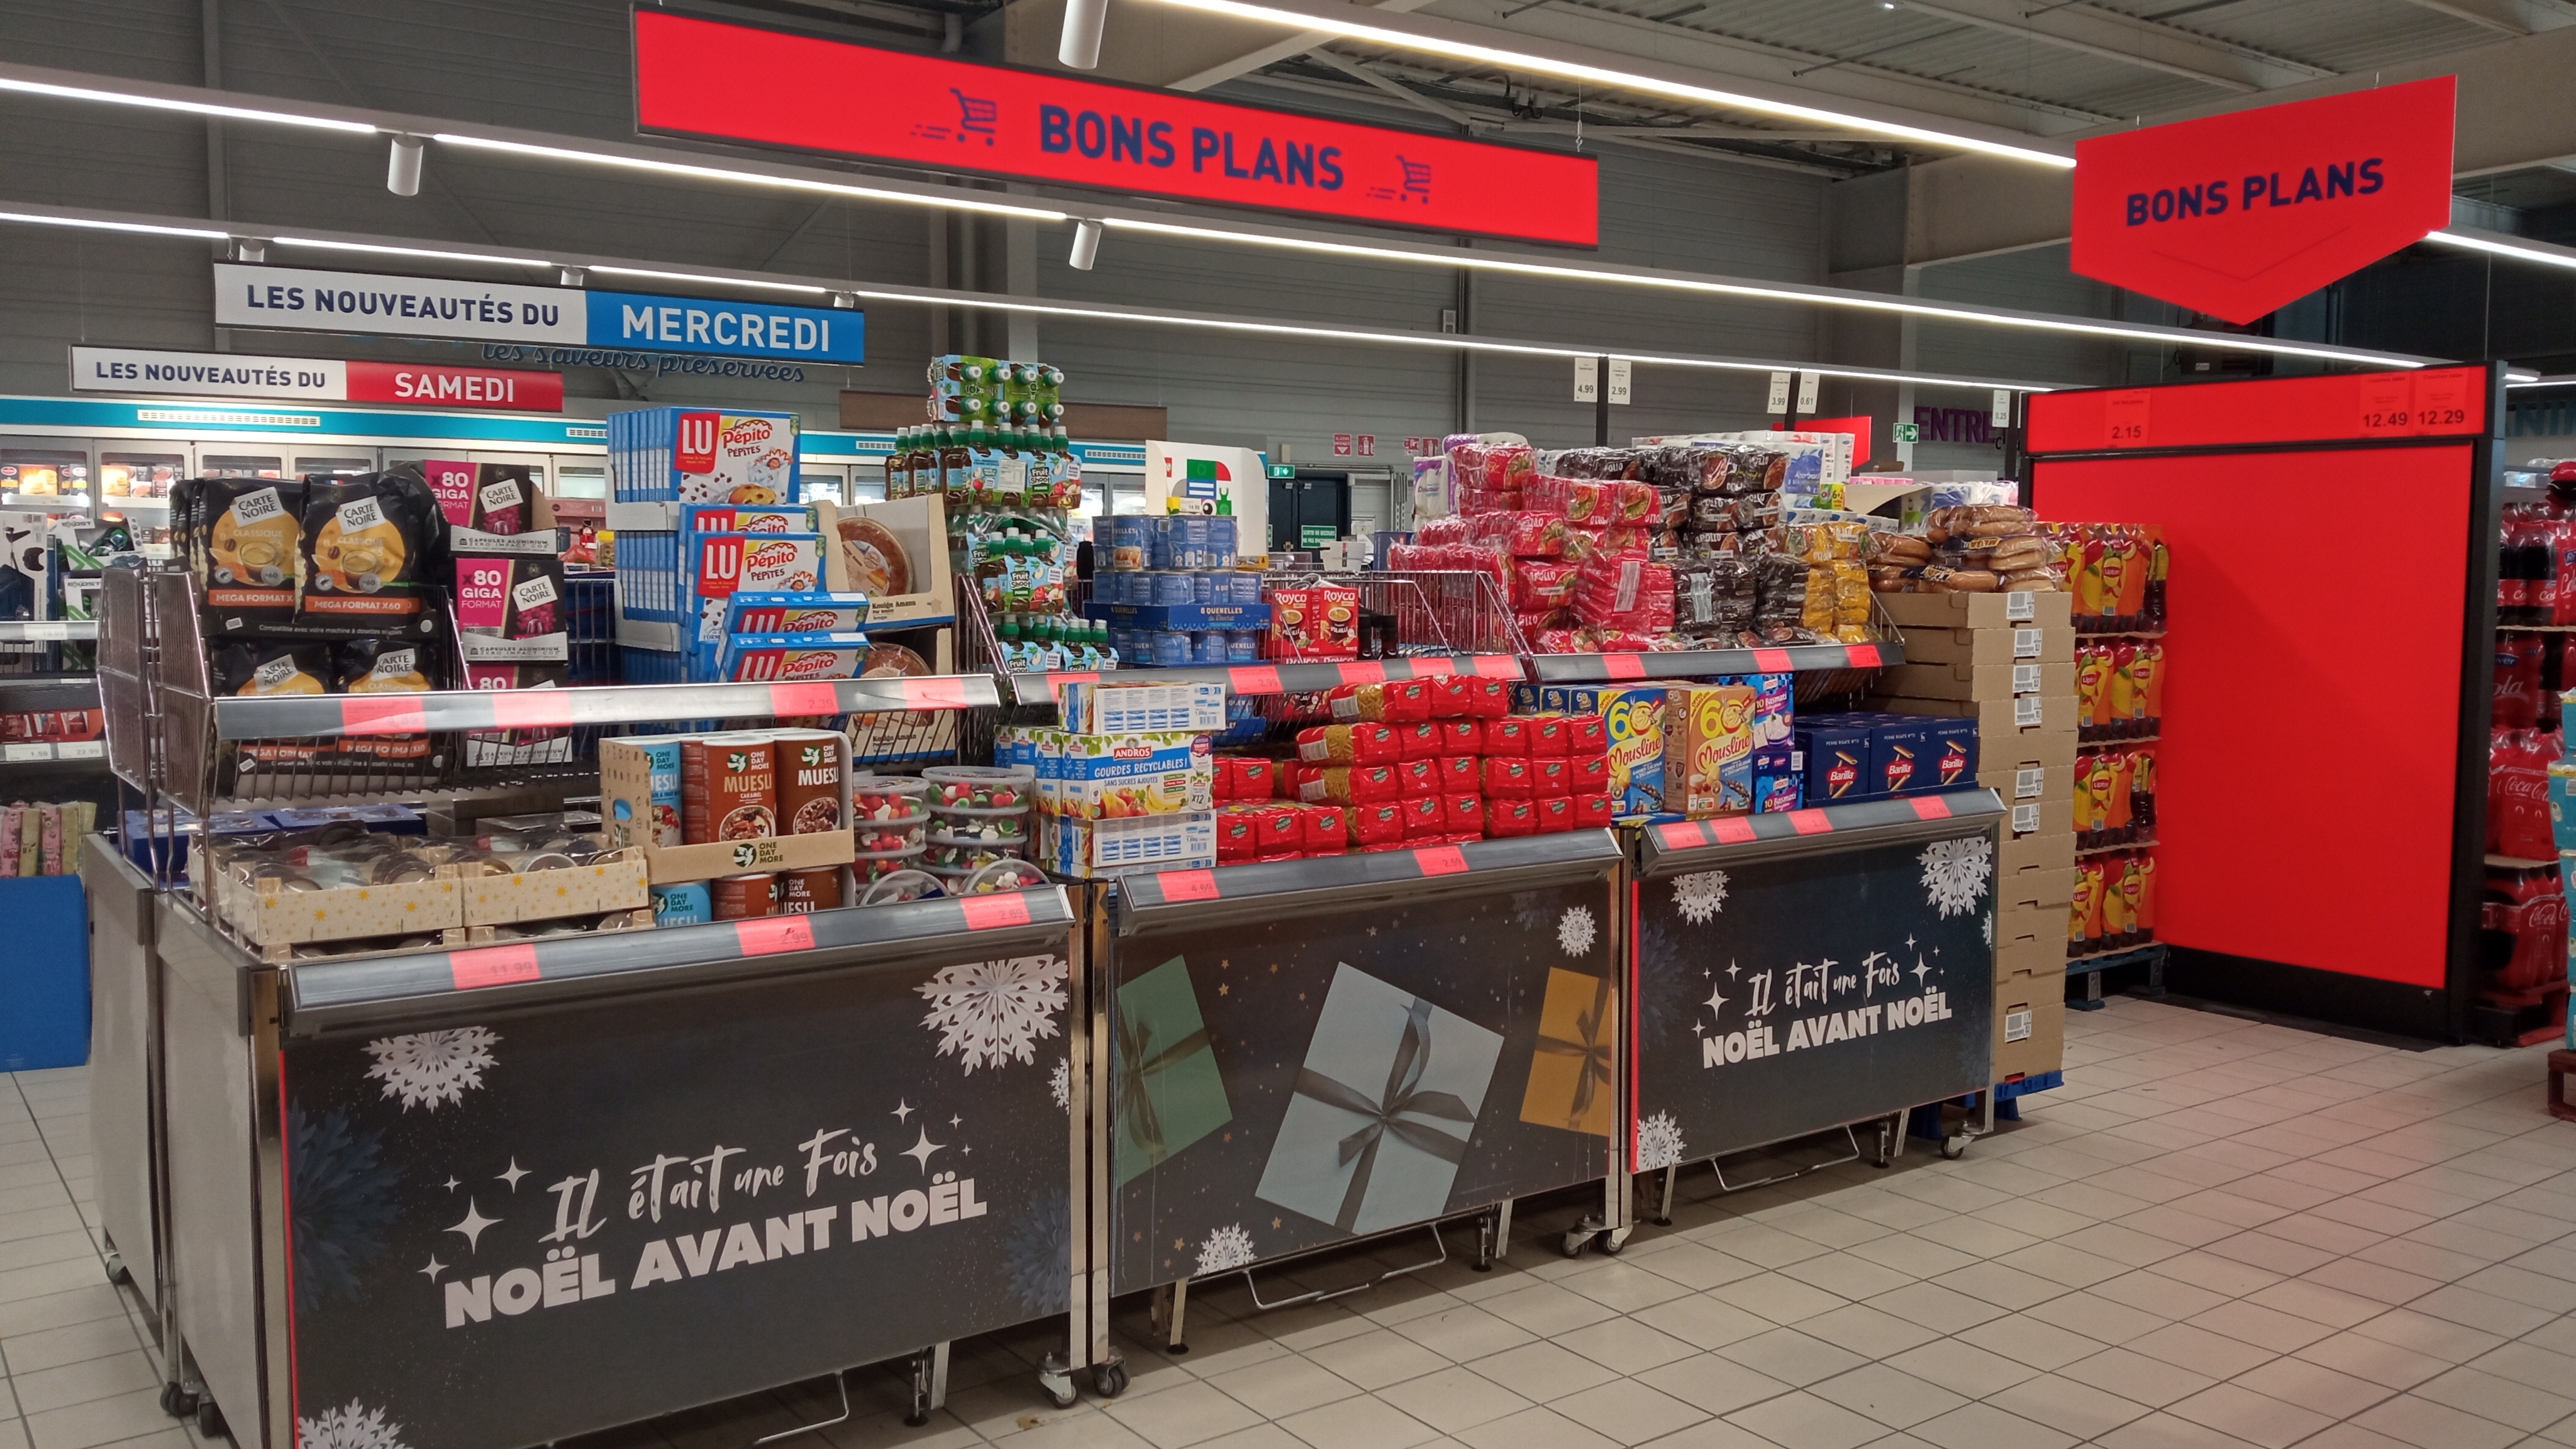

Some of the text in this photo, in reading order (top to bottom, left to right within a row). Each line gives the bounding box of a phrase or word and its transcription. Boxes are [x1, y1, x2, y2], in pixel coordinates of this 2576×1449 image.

[1040, 104, 1344, 191] BONS PLANS
[2126, 158, 2385, 226] BONS PLANS
[247, 285, 830, 352] LES NOUVEAUTÉS DU MERCREDI
[533, 345, 650, 371] saveurs
[96, 360, 514, 403] LES NOUVEAUTÉS DU SAMEDI
[1578, 385, 1594, 394] 4.99
[1611, 387, 1627, 396] 2.99
[1772, 397, 1785, 406] 3.99
[1801, 397, 1813, 406] 0.61
[2363, 413, 2408, 427] 12.49
[2419, 409, 2465, 425] 12.29
[682, 419, 712, 454] LU
[722, 428, 771, 448] Pépito
[2112, 425, 2141, 439] 2.15
[727, 445, 761, 457] PÉPITES
[1030, 477, 1052, 485] Shoot
[486, 486, 514, 499] CARTE
[489, 492, 517, 506] NOIRE
[238, 494, 275, 511] CARTE
[242, 504, 277, 520] NOIRE
[344, 504, 375, 519] CARTE
[347, 513, 378, 528] NOIRE
[706, 545, 736, 579] LU
[746, 552, 796, 572] Pépito
[751, 569, 786, 581] PÉPITES
[519, 582, 548, 597] CARTE
[1011, 580, 1032, 589] Shoot
[462, 587, 502, 599] GIGA
[522, 591, 551, 604] NOIRE
[342, 601, 380, 609] FORMAT
[382, 600, 401, 610] X60
[462, 600, 502, 608] FORMAT
[783, 619, 835, 632] Pépito
[377, 663, 411, 674] NOIRE
[782, 660, 834, 676] Pépito
[264, 667, 293, 686] NOIRE
[1258, 679, 1279, 687] 2.99
[808, 699, 834, 709] 2.39
[1757, 692, 1787, 708] 10 Basmati
[1115, 747, 1151, 758] ANDROS
[1608, 736, 1661, 777] Mousline
[1699, 735, 1750, 773] Mousline
[824, 756, 837, 764] MORE
[1941, 758, 1965, 769] Barilla
[1095, 763, 1131, 777] GOURDES
[1830, 769, 1855, 781] Barilla
[1889, 763, 1913, 775] Barilla
[724, 773, 772, 792] MUESLI
[798, 767, 839, 786] MUESLI
[1136, 775, 1158, 784] AJOUTÉS
[1765, 794, 1796, 808] 10 Basmati
[759, 841, 777, 850] ONE
[759, 854, 783, 864] MORE
[1744, 951, 1901, 1018] Il était une Fois
[1703, 986, 1952, 1069] NOËL AVANT NOËL
[540, 1128, 877, 1244] Il était une Fois
[445, 1172, 987, 1329] NOËL AVANT NOËL
